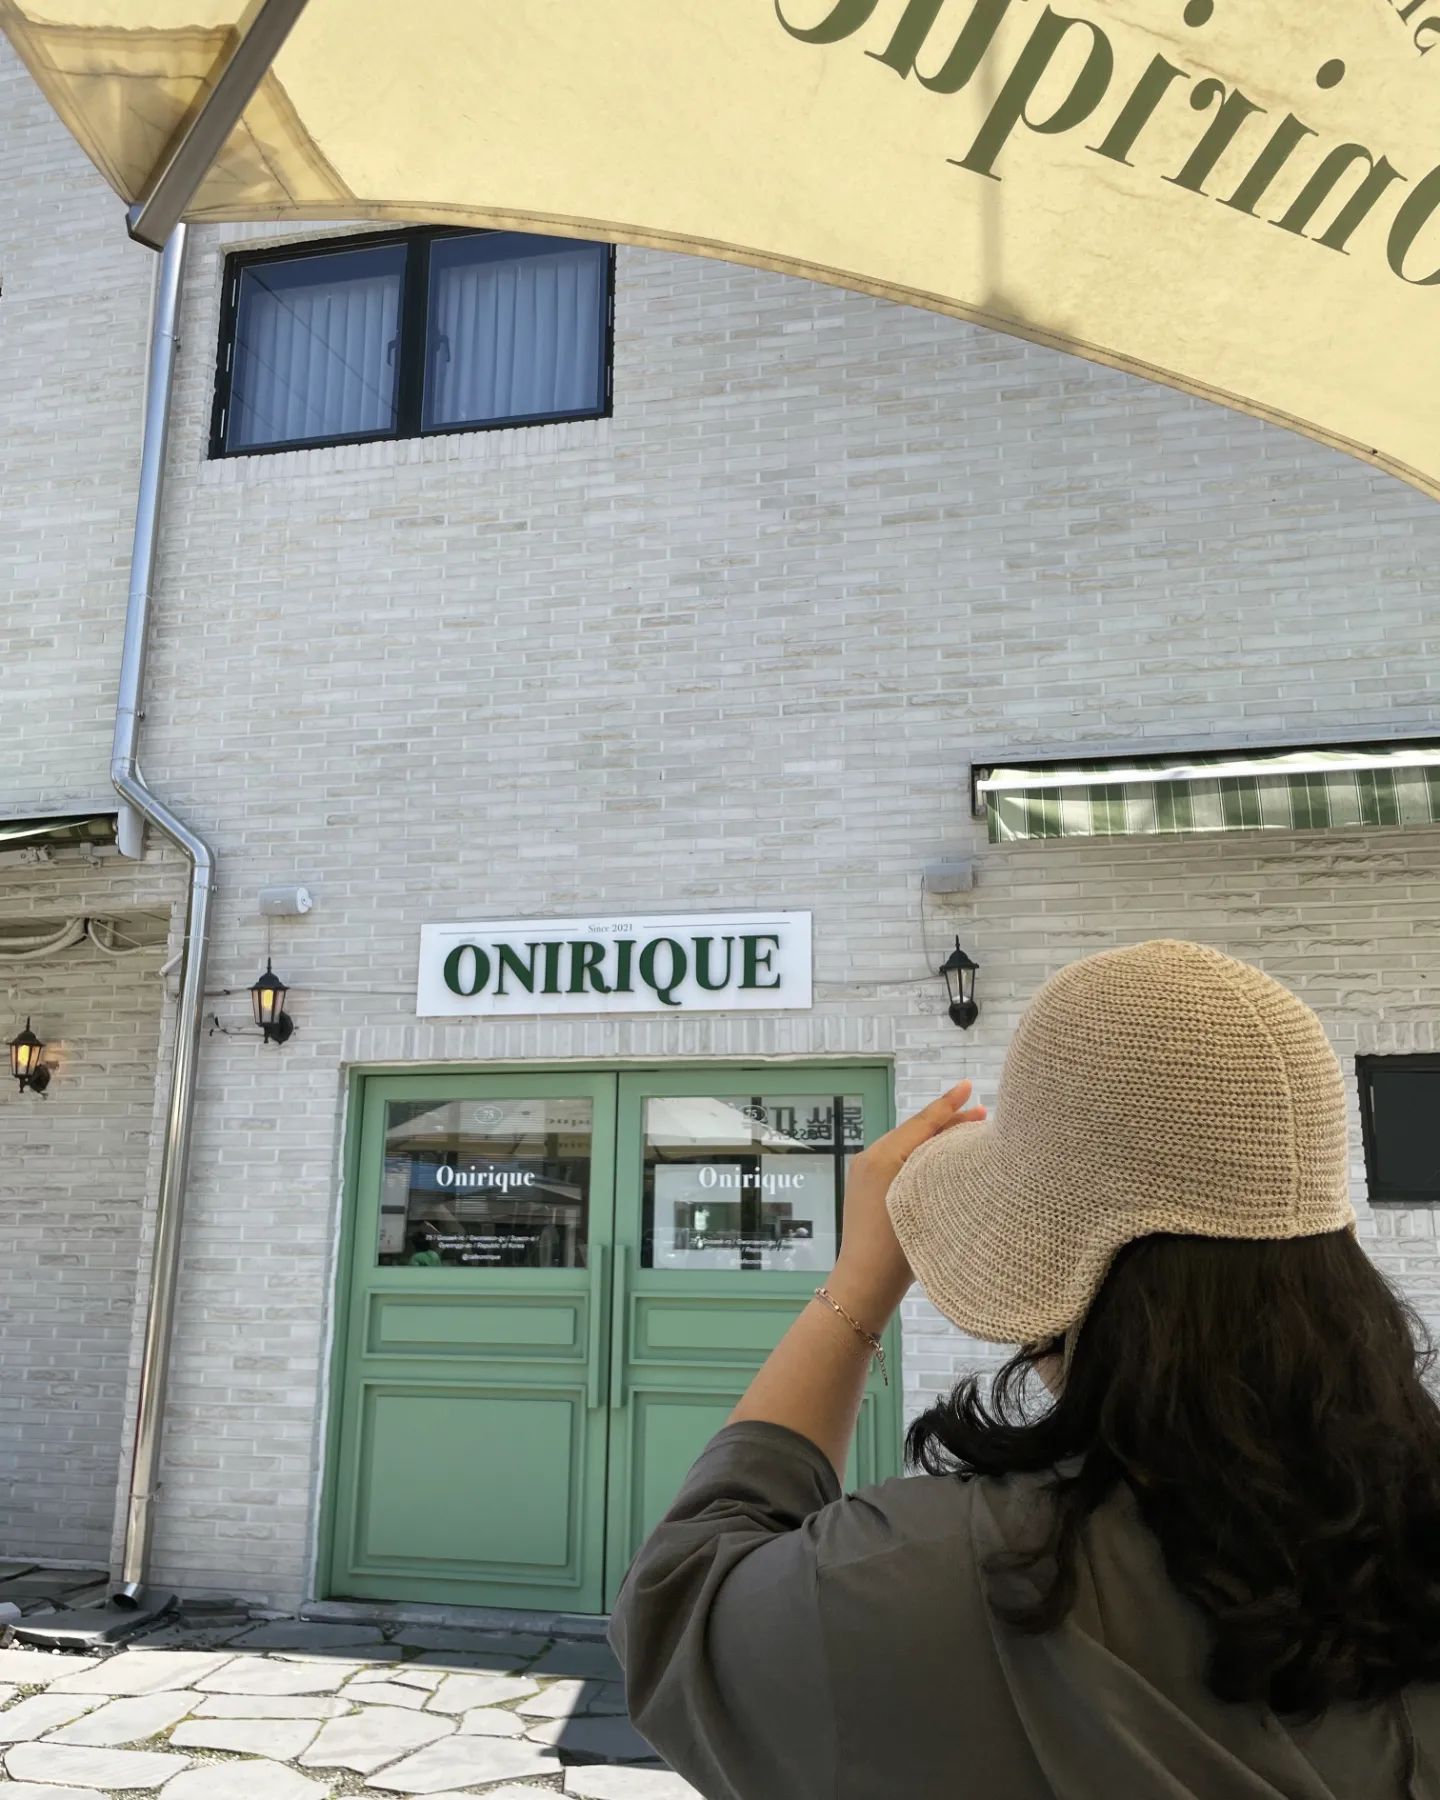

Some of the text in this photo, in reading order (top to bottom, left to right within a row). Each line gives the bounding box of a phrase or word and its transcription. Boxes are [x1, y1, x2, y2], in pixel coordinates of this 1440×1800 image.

[588, 923, 610, 933] Since
[443, 934, 782, 1006] ONIRIQUE
[436, 1165, 536, 1193] Onirique
[698, 1166, 805, 1195] Onirique
